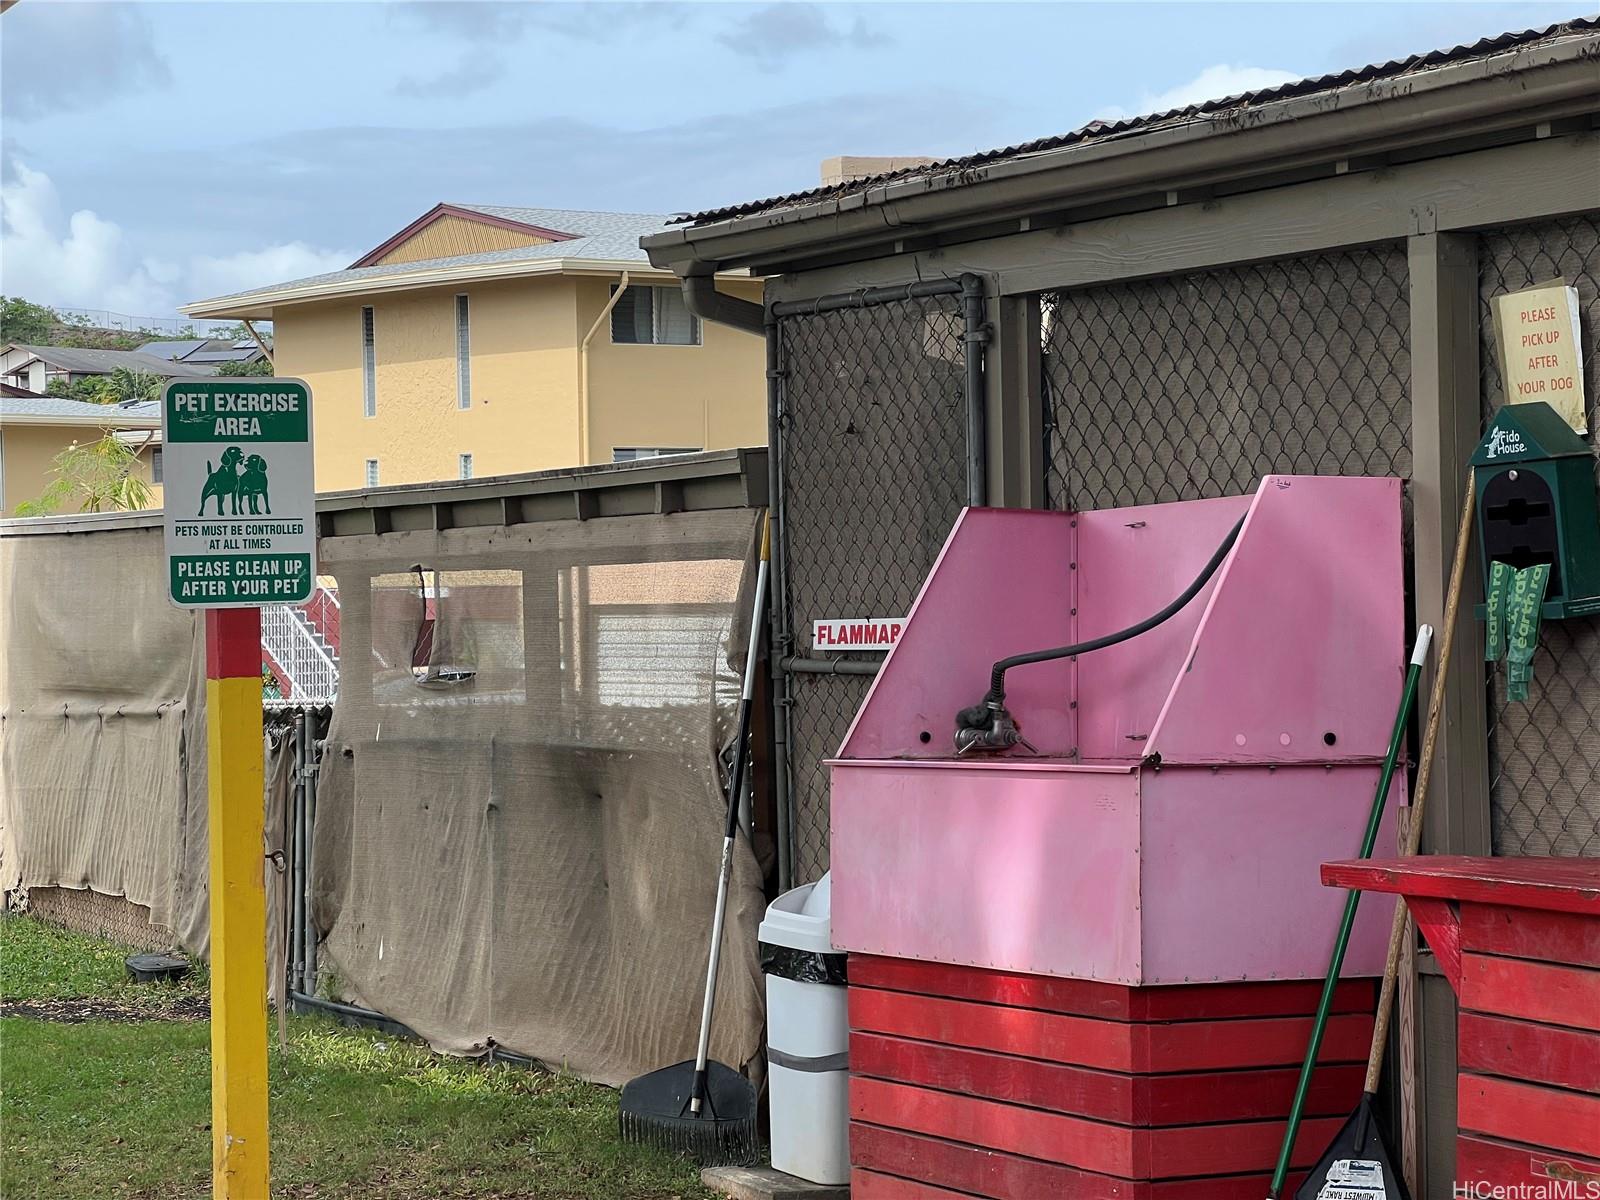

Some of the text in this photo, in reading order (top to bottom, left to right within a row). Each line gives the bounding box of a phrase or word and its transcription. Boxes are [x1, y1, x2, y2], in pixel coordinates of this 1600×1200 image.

[1520, 307, 1556, 324] PLEASE
[1521, 331, 1560, 348] PICK UP
[1528, 354, 1559, 370] AFTER
[1517, 376, 1573, 395] YOUR DOG
[174, 393, 299, 412] PET EXERCISE
[213, 417, 262, 436] AREA
[1500, 430, 1520, 444] Fido
[1497, 442, 1525, 454] House
[175, 524, 304, 536] PETS MUST BE CONTROLLED
[209, 538, 272, 550] AT ALL TIMES
[178, 559, 302, 577] PLEASE CLEAN UP
[181, 579, 300, 597] AFTER YOUR PET
[1488, 590, 1500, 646] earth
[1518, 593, 1536, 649] earth
